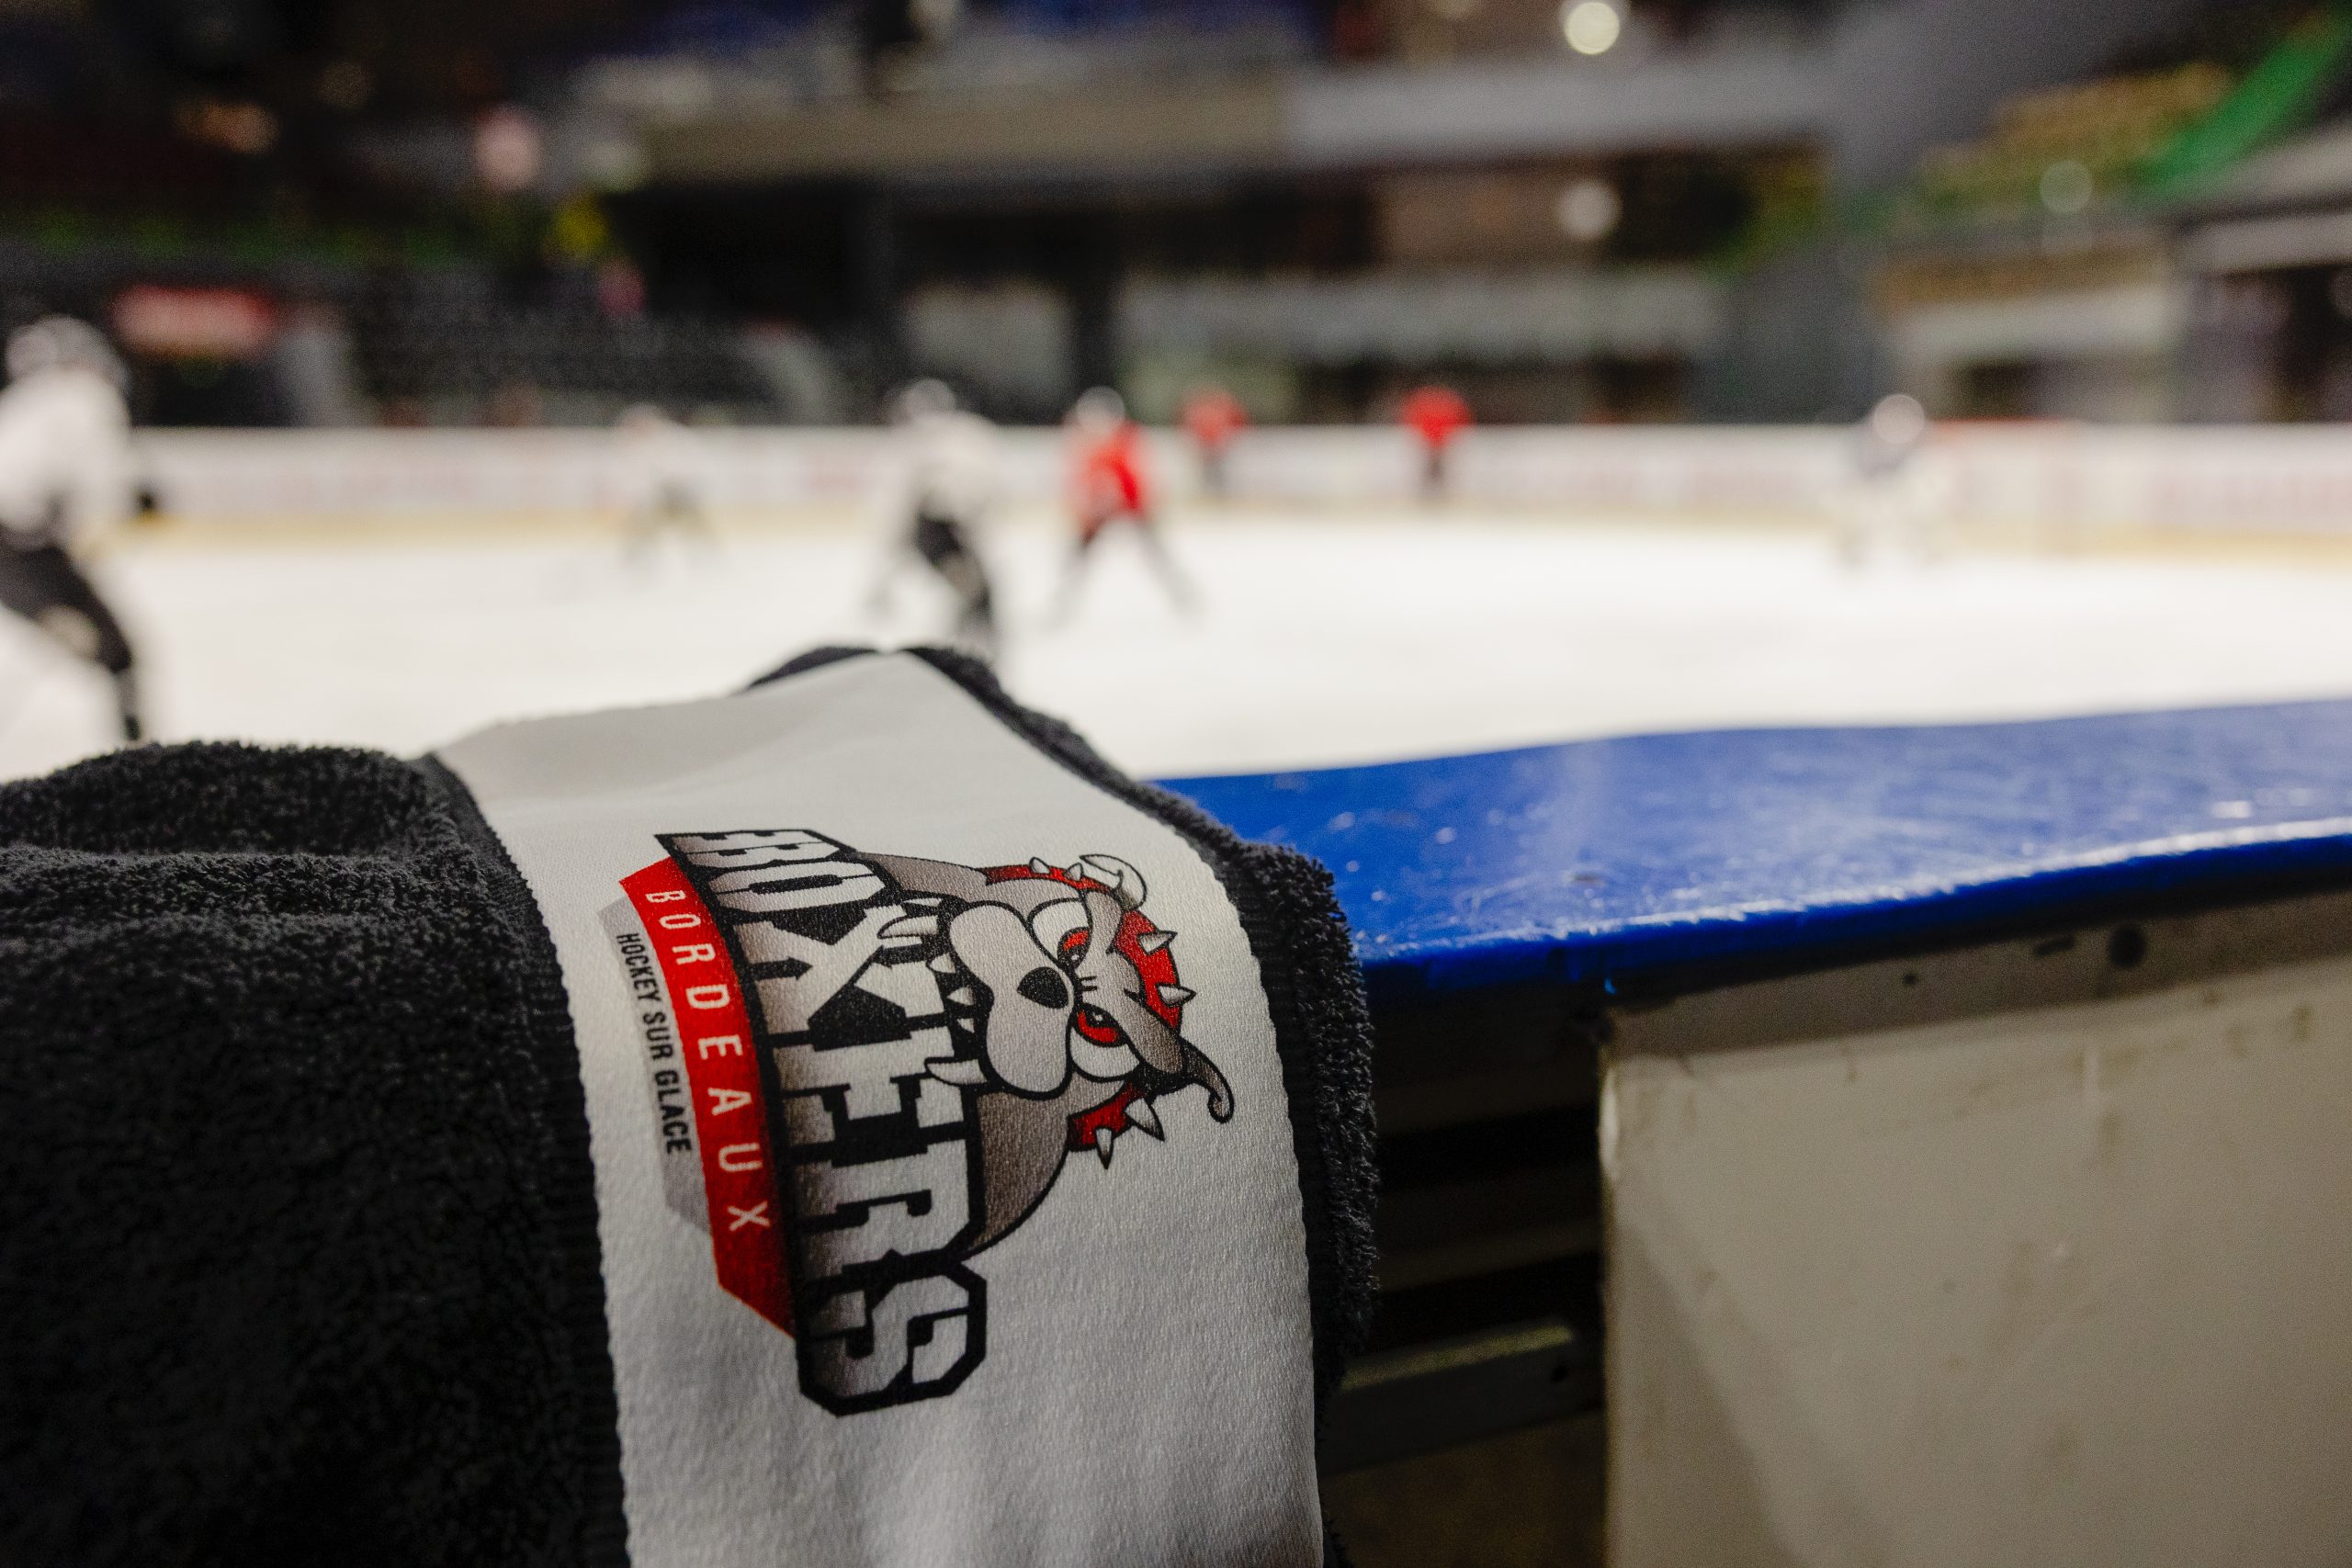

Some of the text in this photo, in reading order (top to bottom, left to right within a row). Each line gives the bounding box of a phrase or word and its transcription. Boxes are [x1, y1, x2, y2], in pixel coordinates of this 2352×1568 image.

[616, 932, 693, 1155] HOCKEY SUR GLACE
[646, 890, 770, 1231] BORDEAUX
[655, 829, 987, 1416] BOXERS
